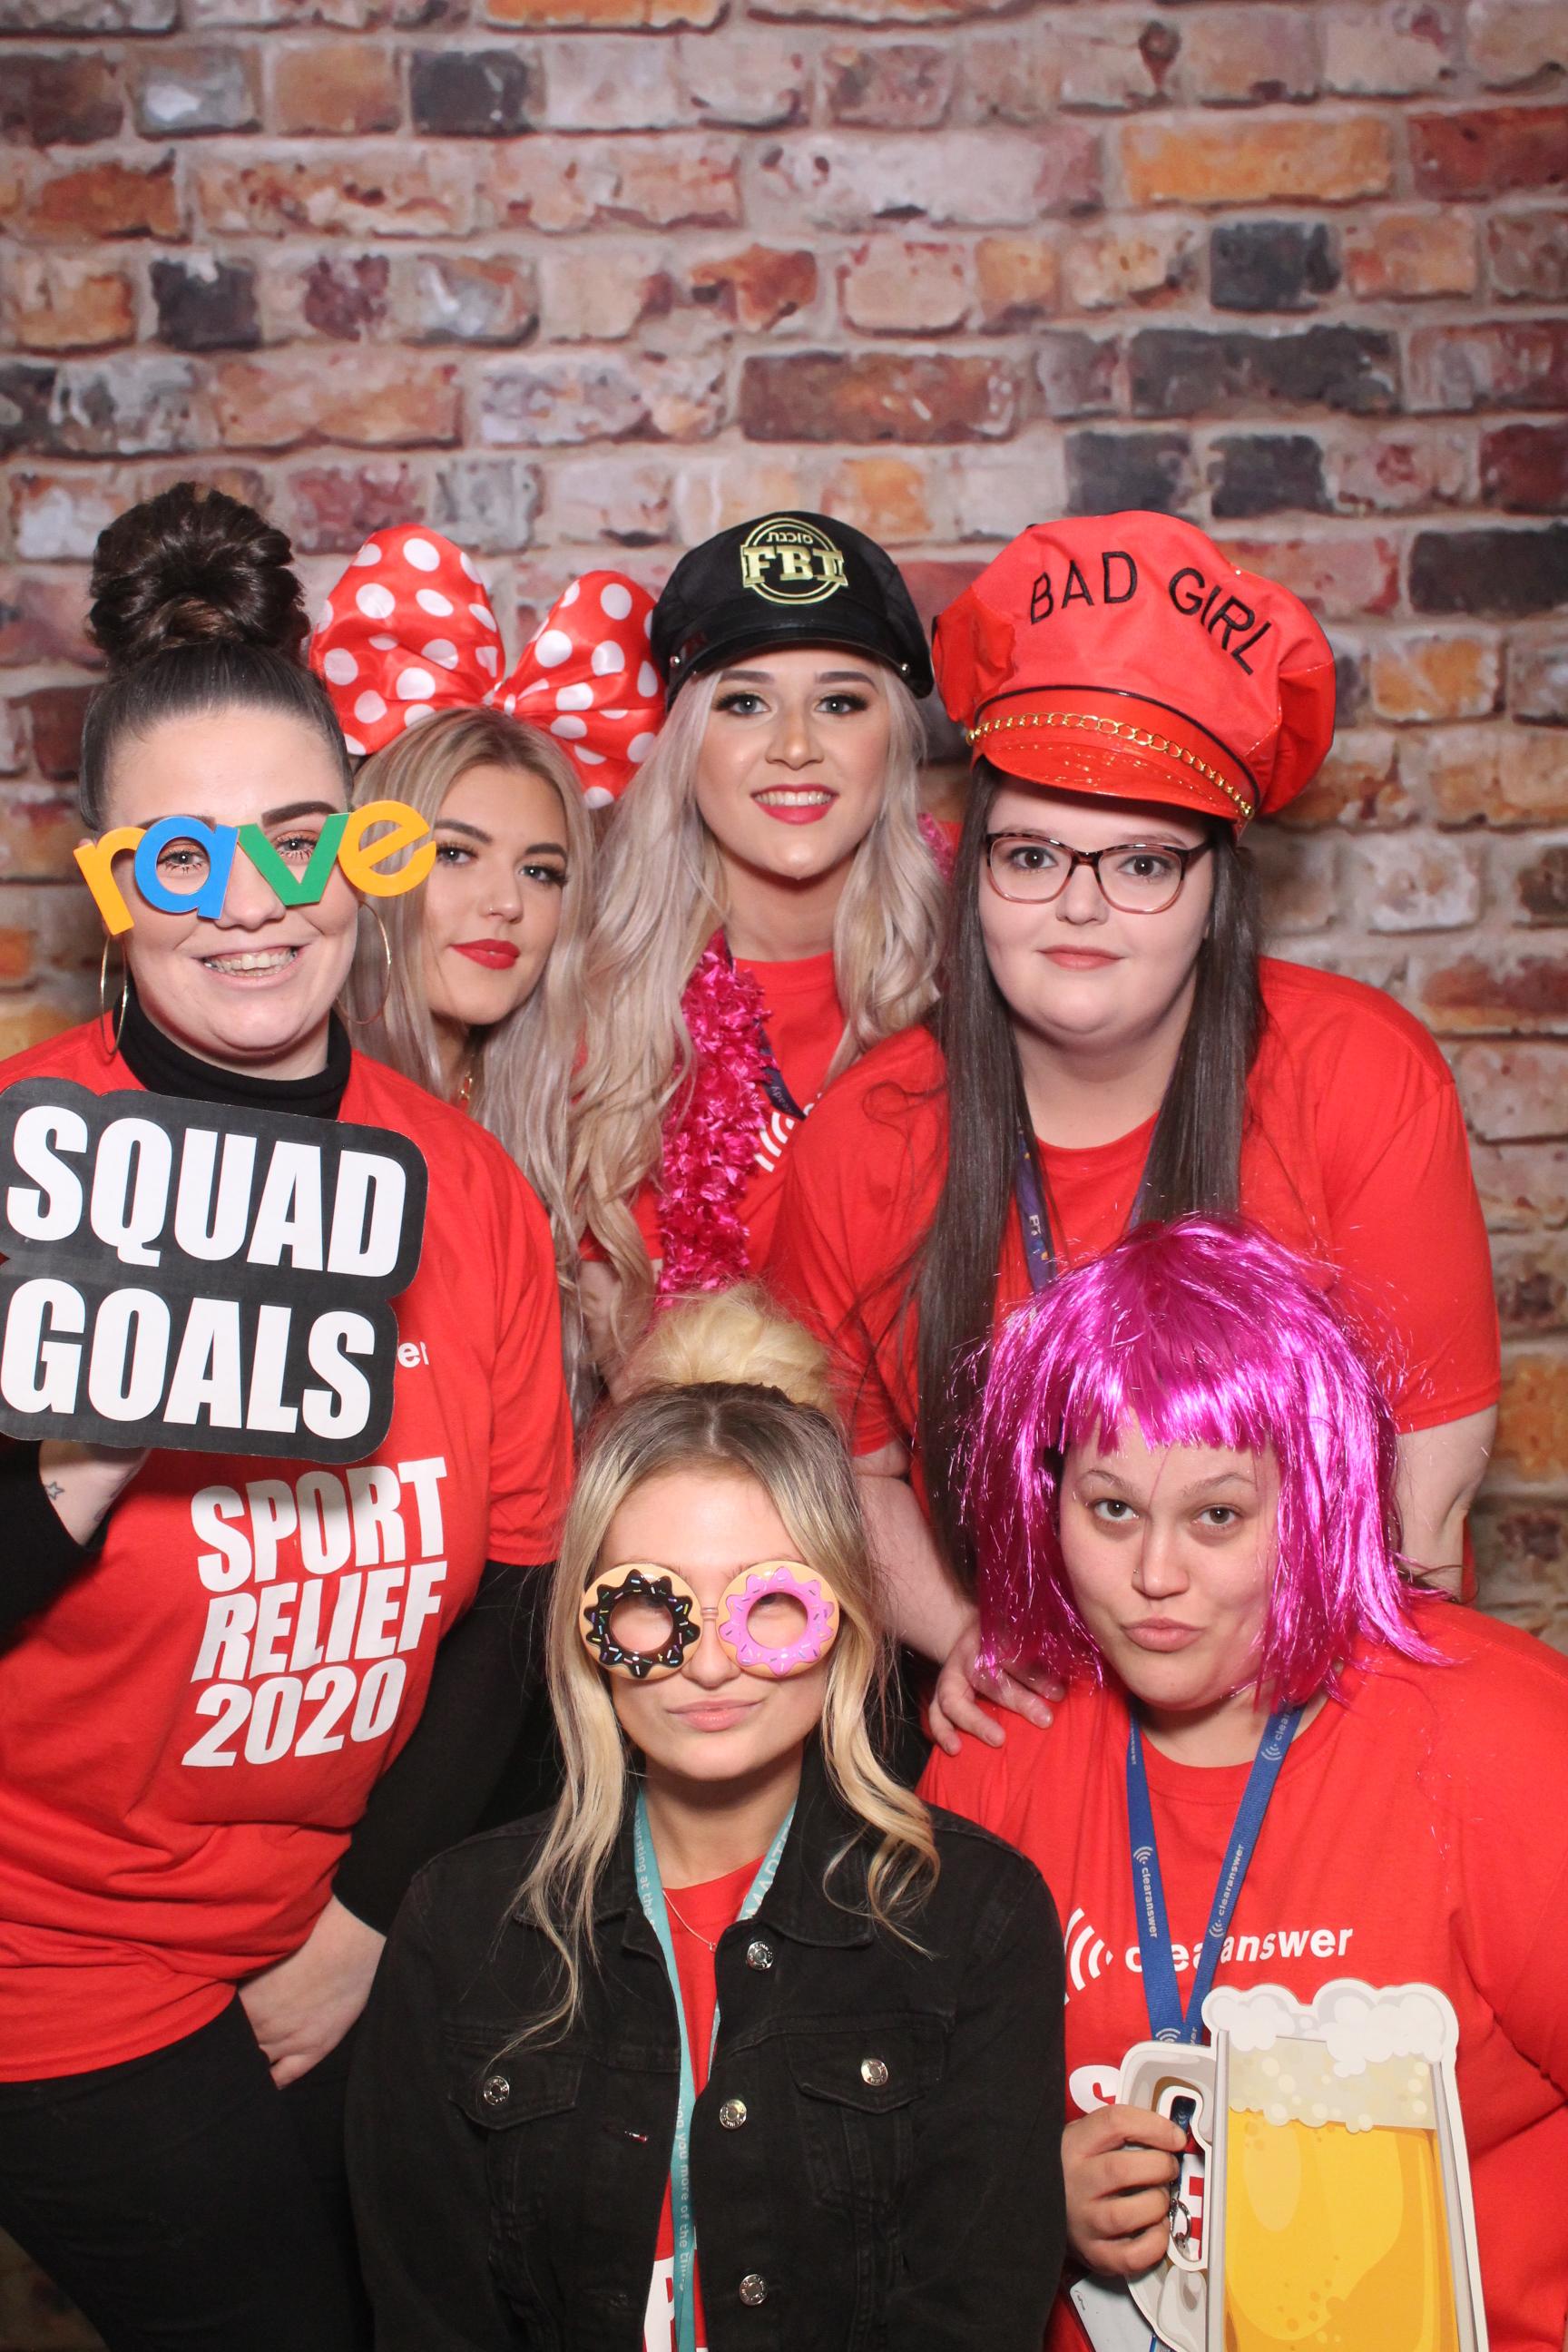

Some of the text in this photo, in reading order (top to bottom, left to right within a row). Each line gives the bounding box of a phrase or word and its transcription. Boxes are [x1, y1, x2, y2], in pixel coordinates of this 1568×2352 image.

[741, 544, 848, 588] FBI
[1030, 551, 1271, 676] BAD GIRL
[73, 799, 437, 936] rave
[6, 1105, 407, 1278] SQUAD
[0, 1278, 376, 1440] GOALS
[191, 1456, 448, 1592] SPORT
[191, 1560, 448, 1683] RELIEF
[181, 1657, 407, 1768] 2020
[640, 1875, 650, 1890] at
[1142, 1867, 1158, 1939] clearanswer
[1219, 1843, 1245, 1916] clearanswer
[675, 2132, 689, 2160] you
[680, 2163, 690, 2200] more
[679, 2223, 690, 2248] the
